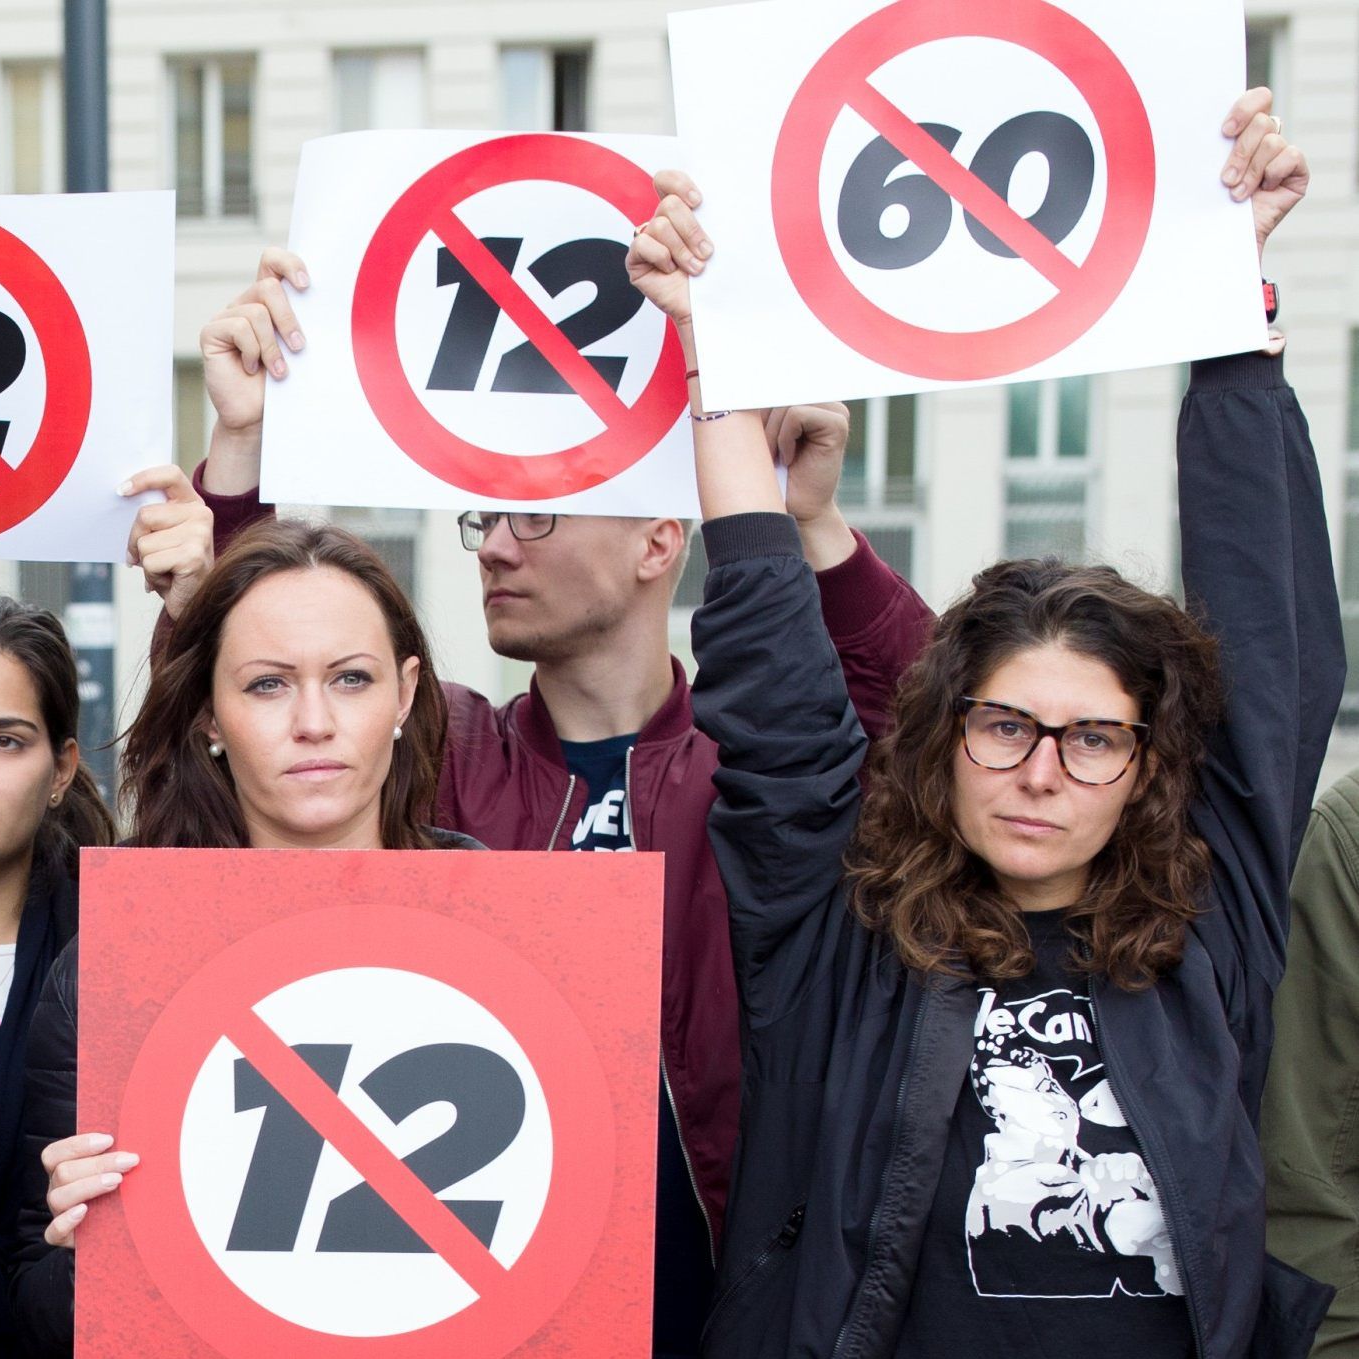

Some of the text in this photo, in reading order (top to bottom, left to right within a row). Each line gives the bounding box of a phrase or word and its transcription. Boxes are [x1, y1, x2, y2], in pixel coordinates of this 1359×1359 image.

[837, 110, 1095, 271] 60
[426, 237, 646, 396] 12
[225, 1043, 526, 1252] 12
